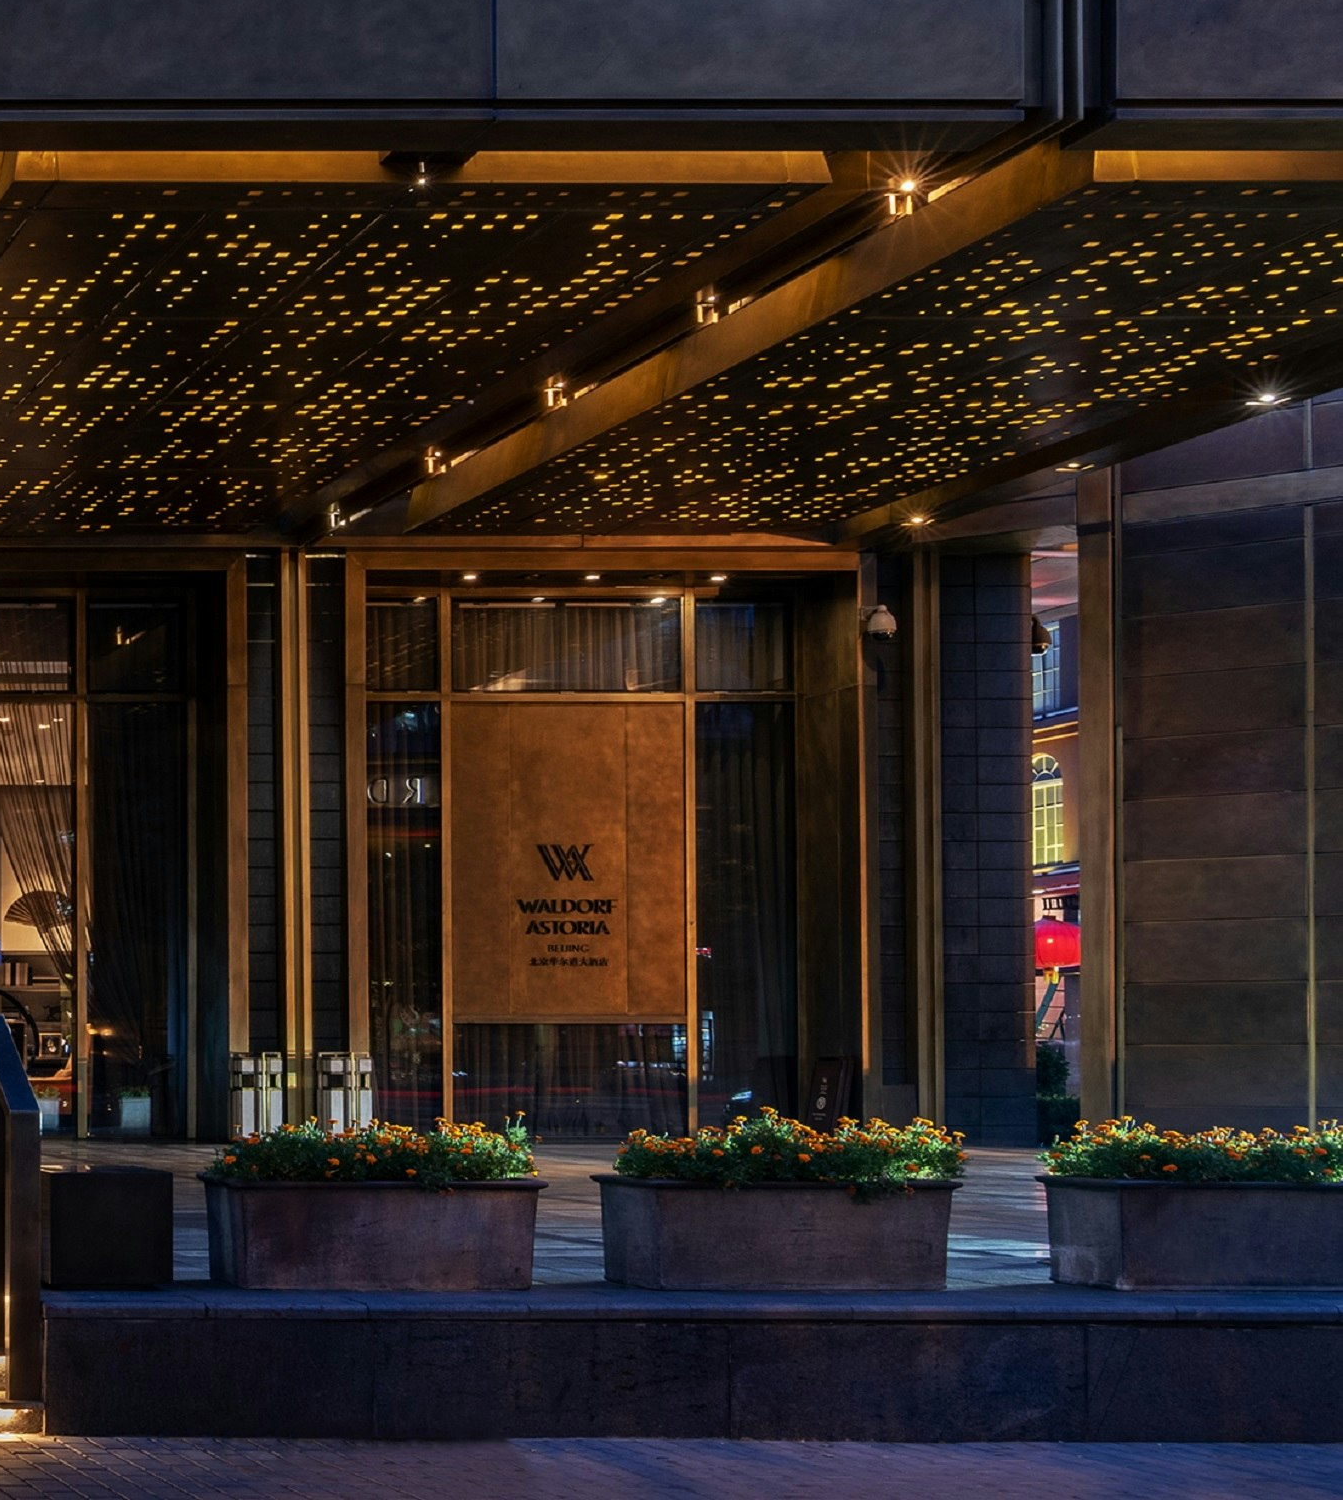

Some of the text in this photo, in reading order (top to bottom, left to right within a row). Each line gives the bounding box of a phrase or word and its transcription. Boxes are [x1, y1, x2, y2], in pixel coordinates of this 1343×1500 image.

[516, 899, 617, 914] WALDORF
[525, 920, 610, 935] ASTORIA
[547, 944, 590, 953] BEIJING
